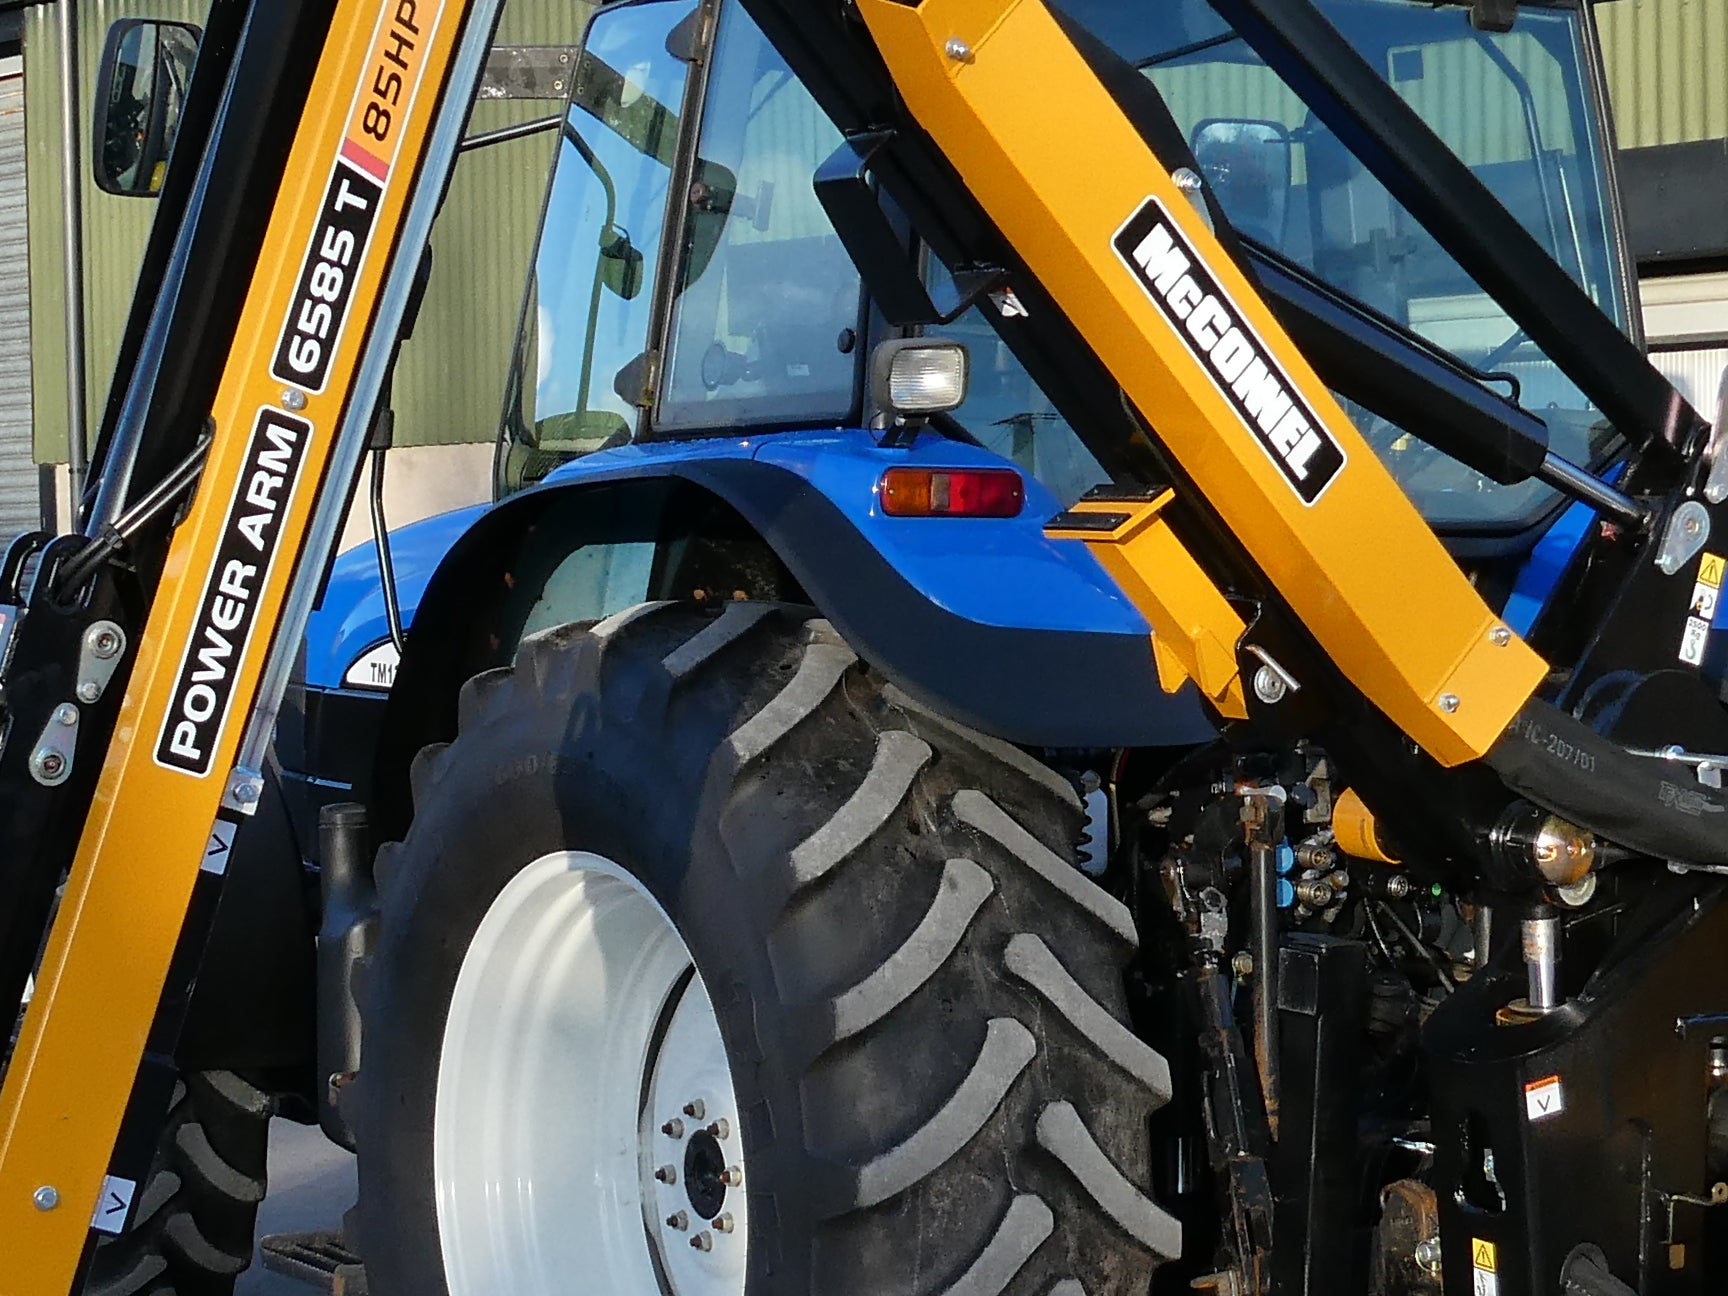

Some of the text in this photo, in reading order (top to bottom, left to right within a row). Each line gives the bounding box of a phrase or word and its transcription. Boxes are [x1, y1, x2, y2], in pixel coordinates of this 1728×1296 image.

[288, 178, 369, 374] 6585 T
[169, 422, 298, 761] POWER ARM
[370, 662, 400, 684] TM1
